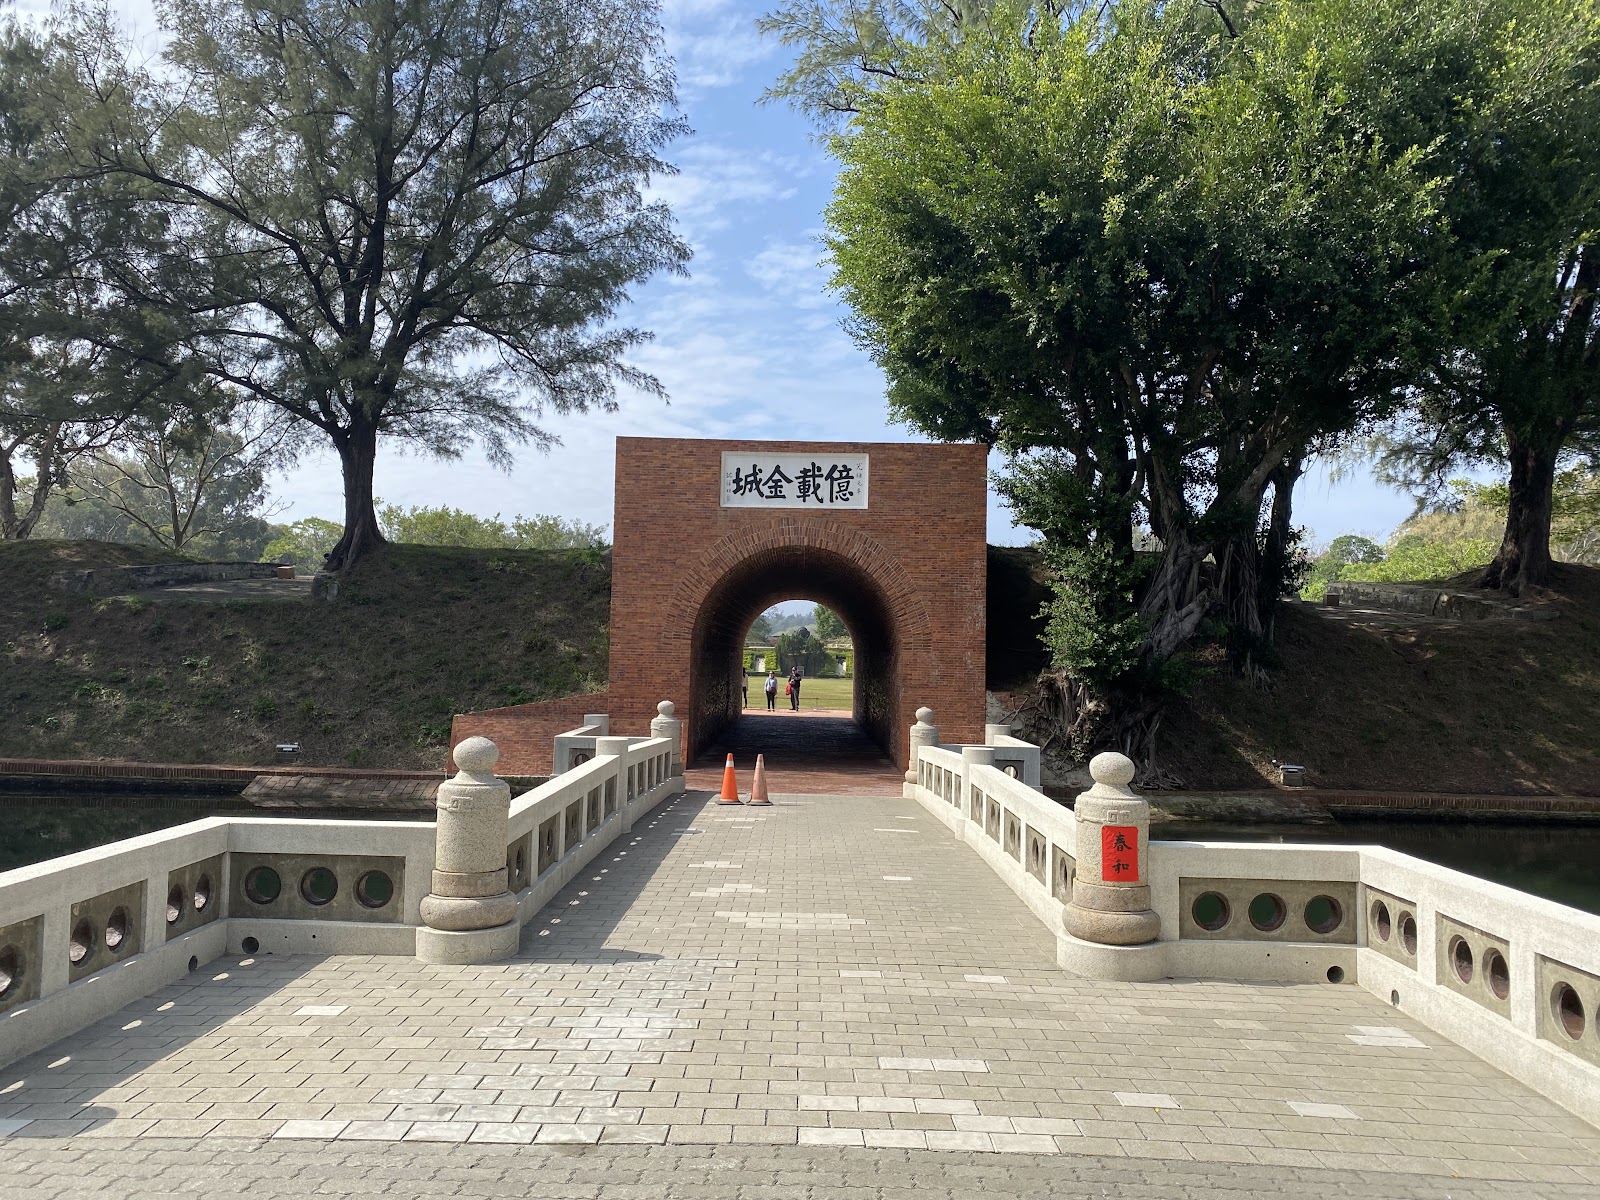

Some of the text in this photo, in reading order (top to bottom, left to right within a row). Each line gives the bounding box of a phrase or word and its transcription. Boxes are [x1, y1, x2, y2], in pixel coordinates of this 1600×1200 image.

[732, 462, 855, 503] 億載金城
[1111, 832, 1132, 874] 春和
